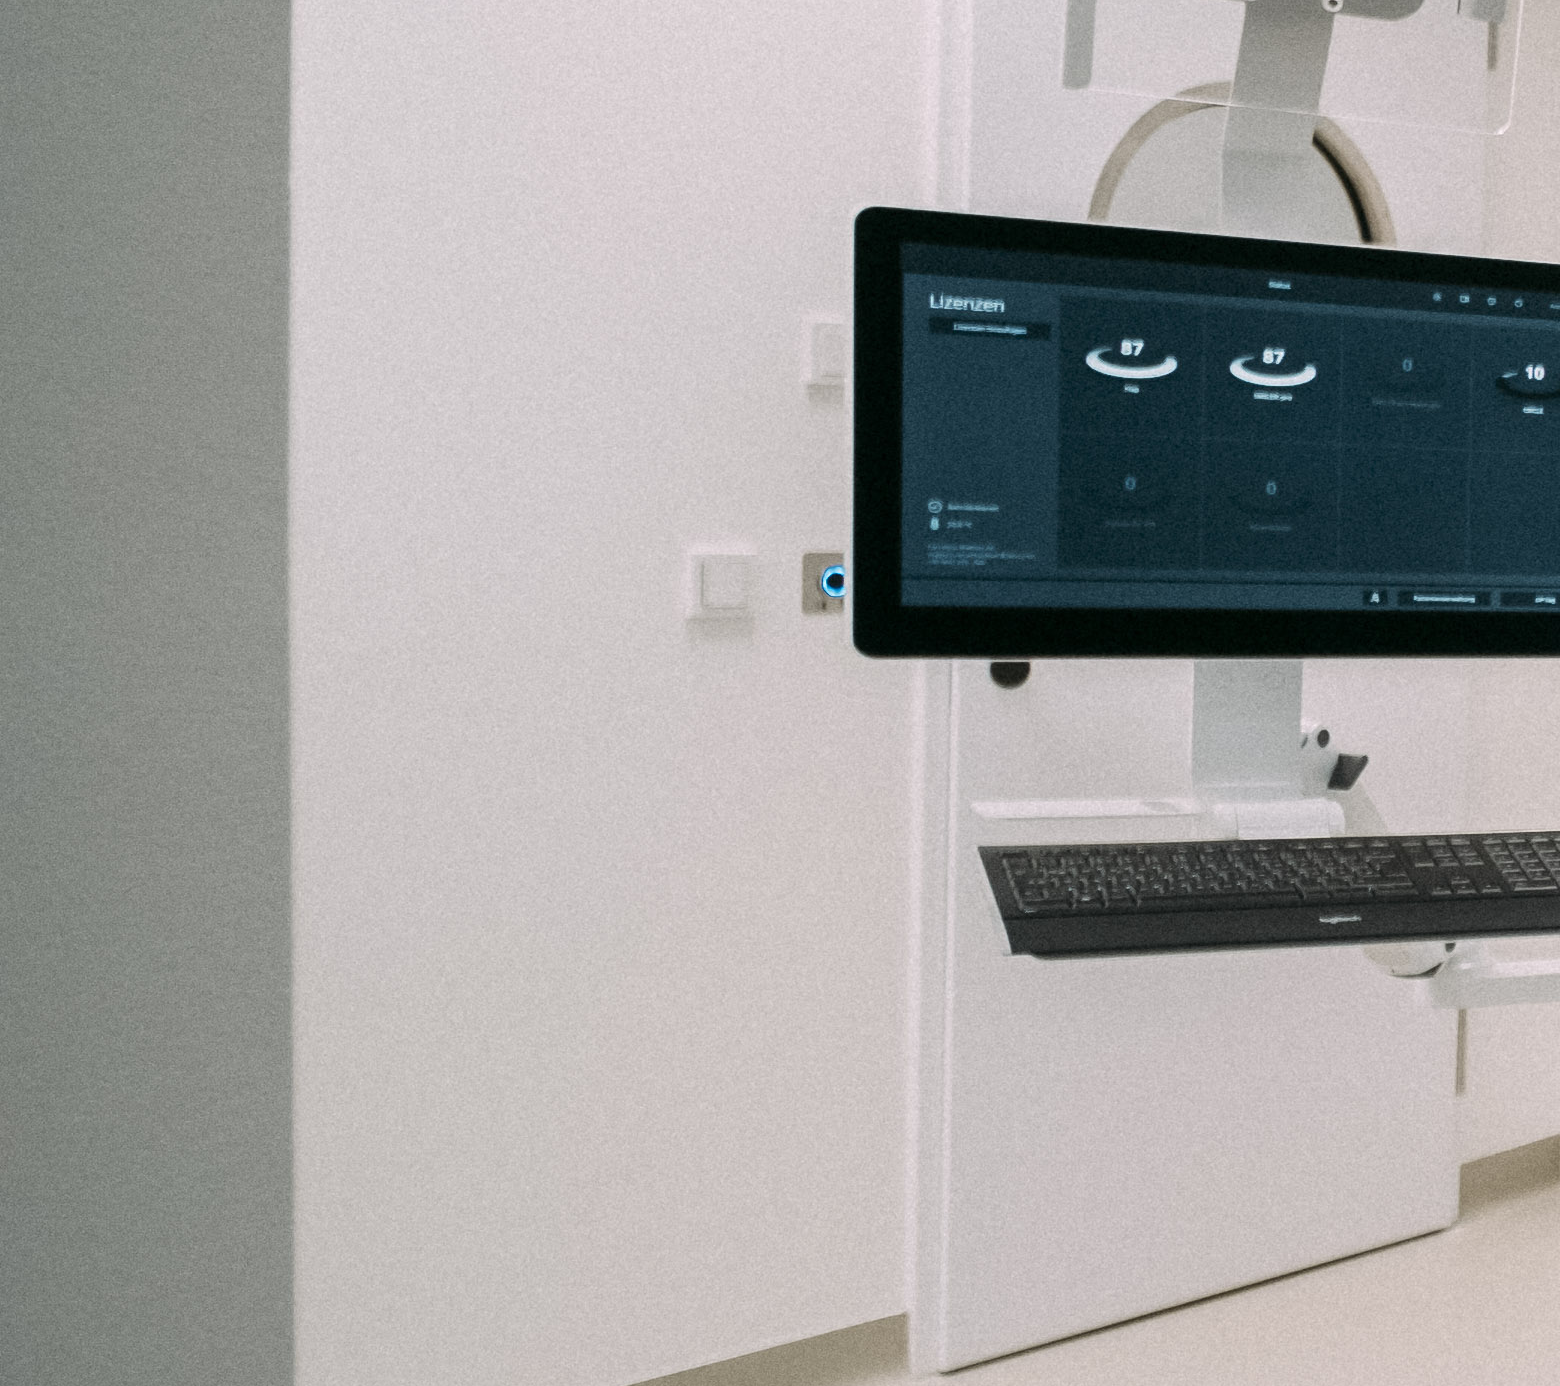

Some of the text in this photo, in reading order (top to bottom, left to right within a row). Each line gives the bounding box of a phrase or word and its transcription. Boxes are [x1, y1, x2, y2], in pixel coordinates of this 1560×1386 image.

[929, 292, 1005, 313] Lizenzen
[1120, 339, 1144, 356] 87
[1262, 348, 1285, 364] 87
[1525, 364, 1545, 380] 10
